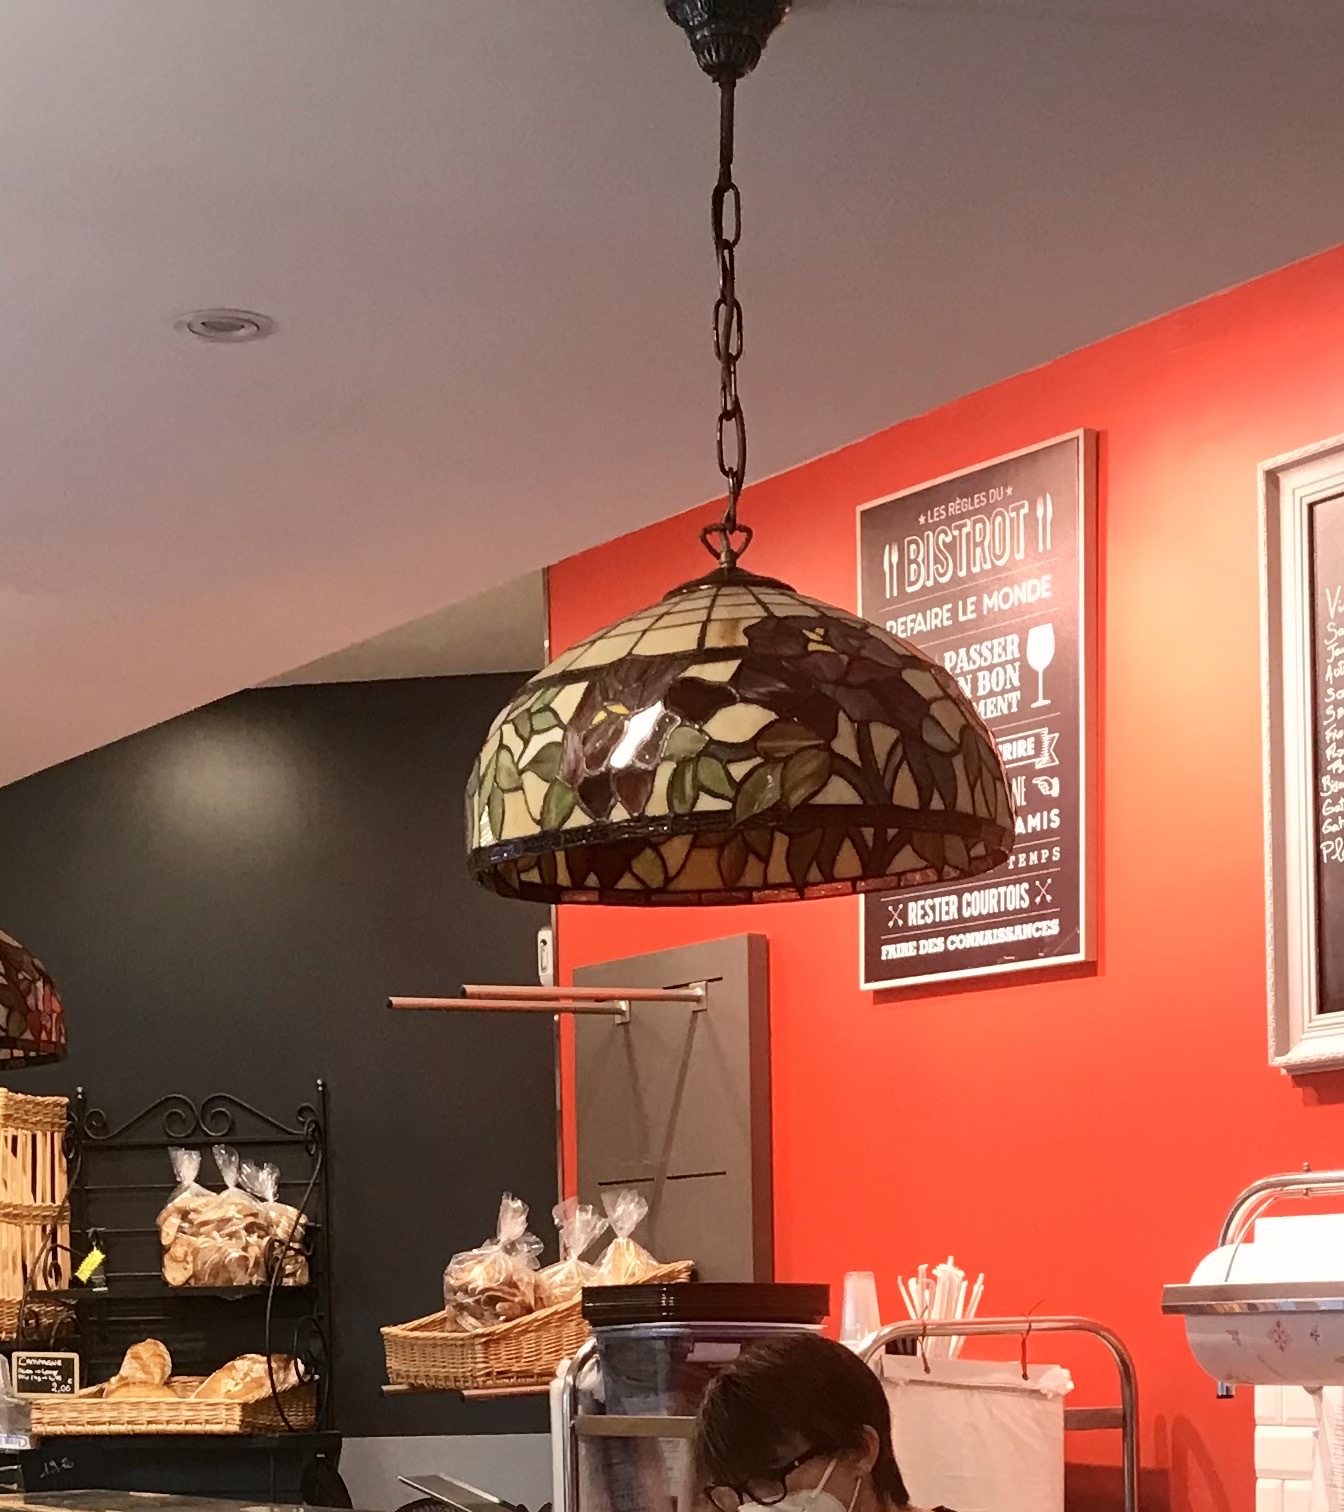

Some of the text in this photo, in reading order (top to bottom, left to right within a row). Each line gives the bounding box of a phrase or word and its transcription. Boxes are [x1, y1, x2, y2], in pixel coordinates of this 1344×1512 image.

[928, 486, 1004, 523] LES RÈGLES DU
[905, 500, 1029, 593] BISTROT
[958, 596, 977, 622] LE
[983, 574, 1052, 615] MONDE
[944, 633, 1020, 674] PASSER
[977, 662, 1020, 696] BON
[1015, 809, 1060, 835] AMIS
[1007, 847, 1061, 869] TEMPS
[908, 882, 1030, 926] RESTER COURTOIS
[881, 918, 1060, 960] FAIRE DES CONNAISSANCES
